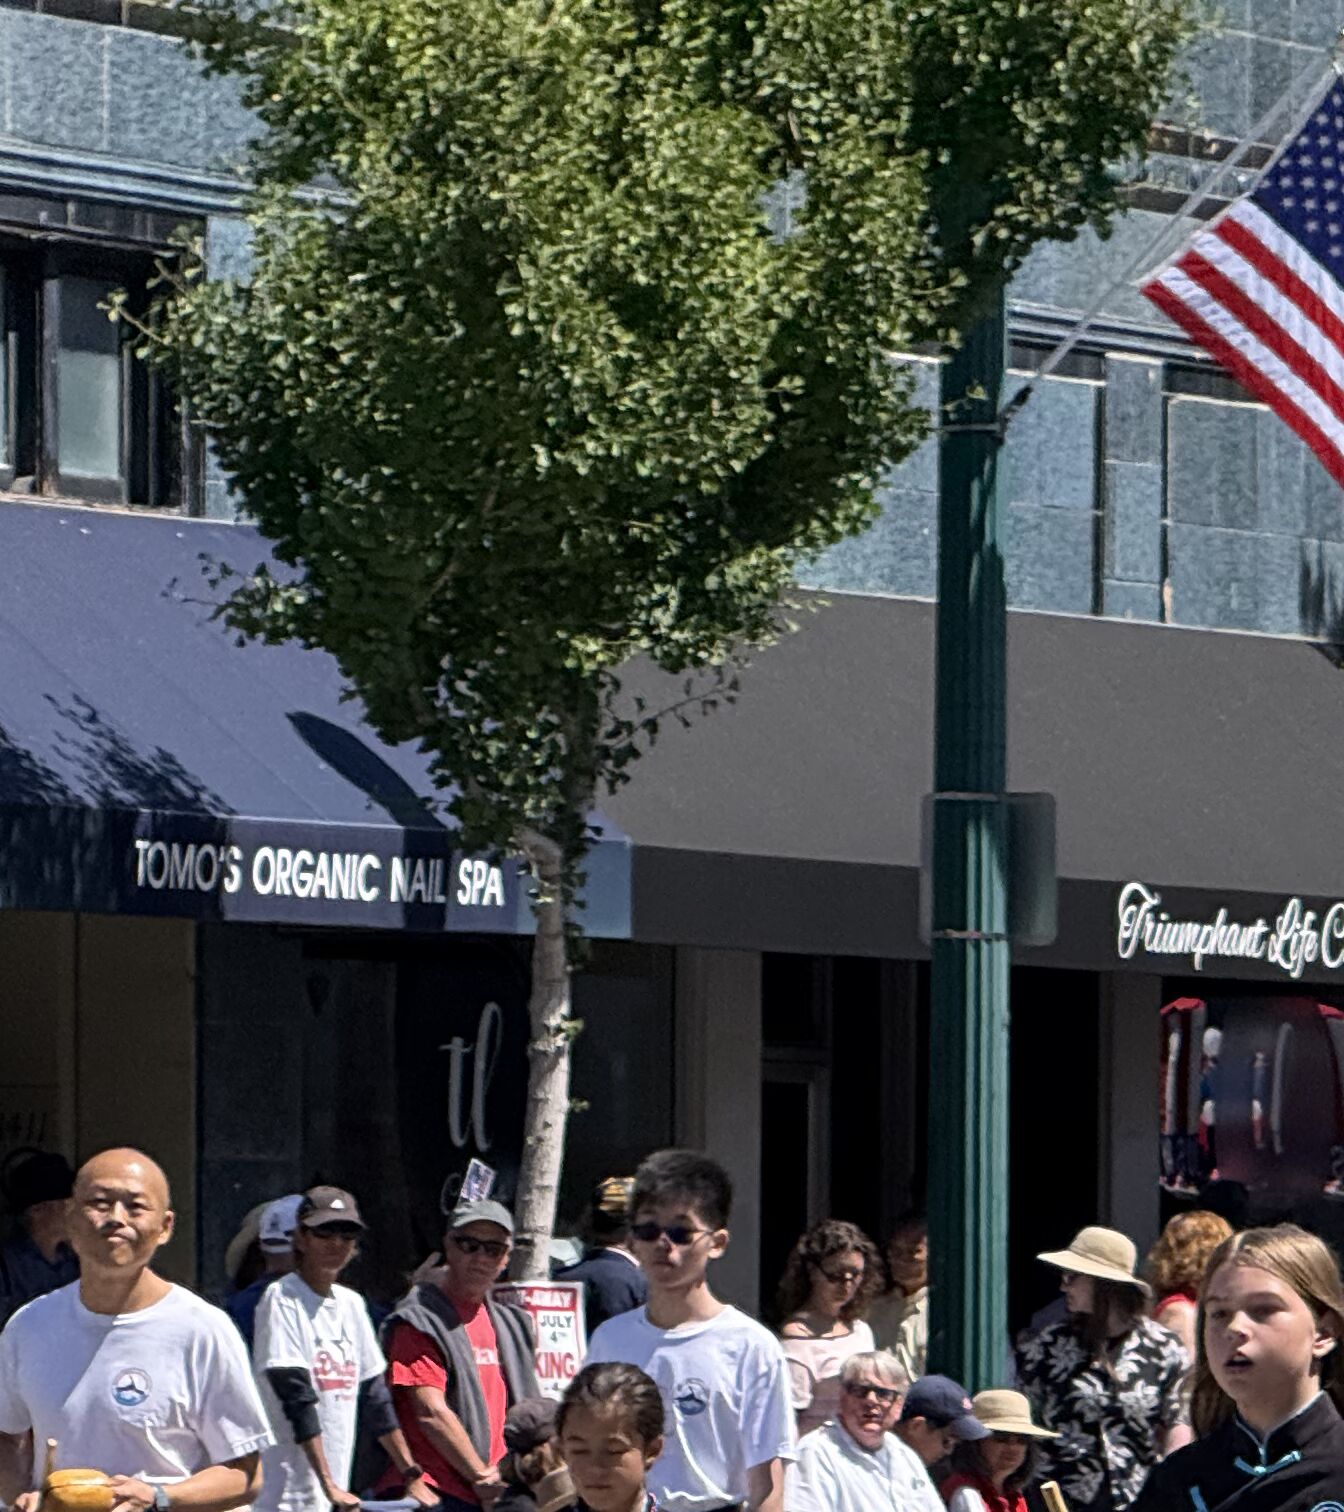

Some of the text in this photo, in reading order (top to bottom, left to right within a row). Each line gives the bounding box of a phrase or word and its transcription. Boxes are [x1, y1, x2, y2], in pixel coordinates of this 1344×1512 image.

[135, 840, 506, 906] TOMO'S ORGANIC NAIL SPA
[1118, 881, 1269, 971] Triumphant
[1268, 897, 1319, 978] Life
[540, 1315, 573, 1328] JULY
[535, 1352, 576, 1378] KING
